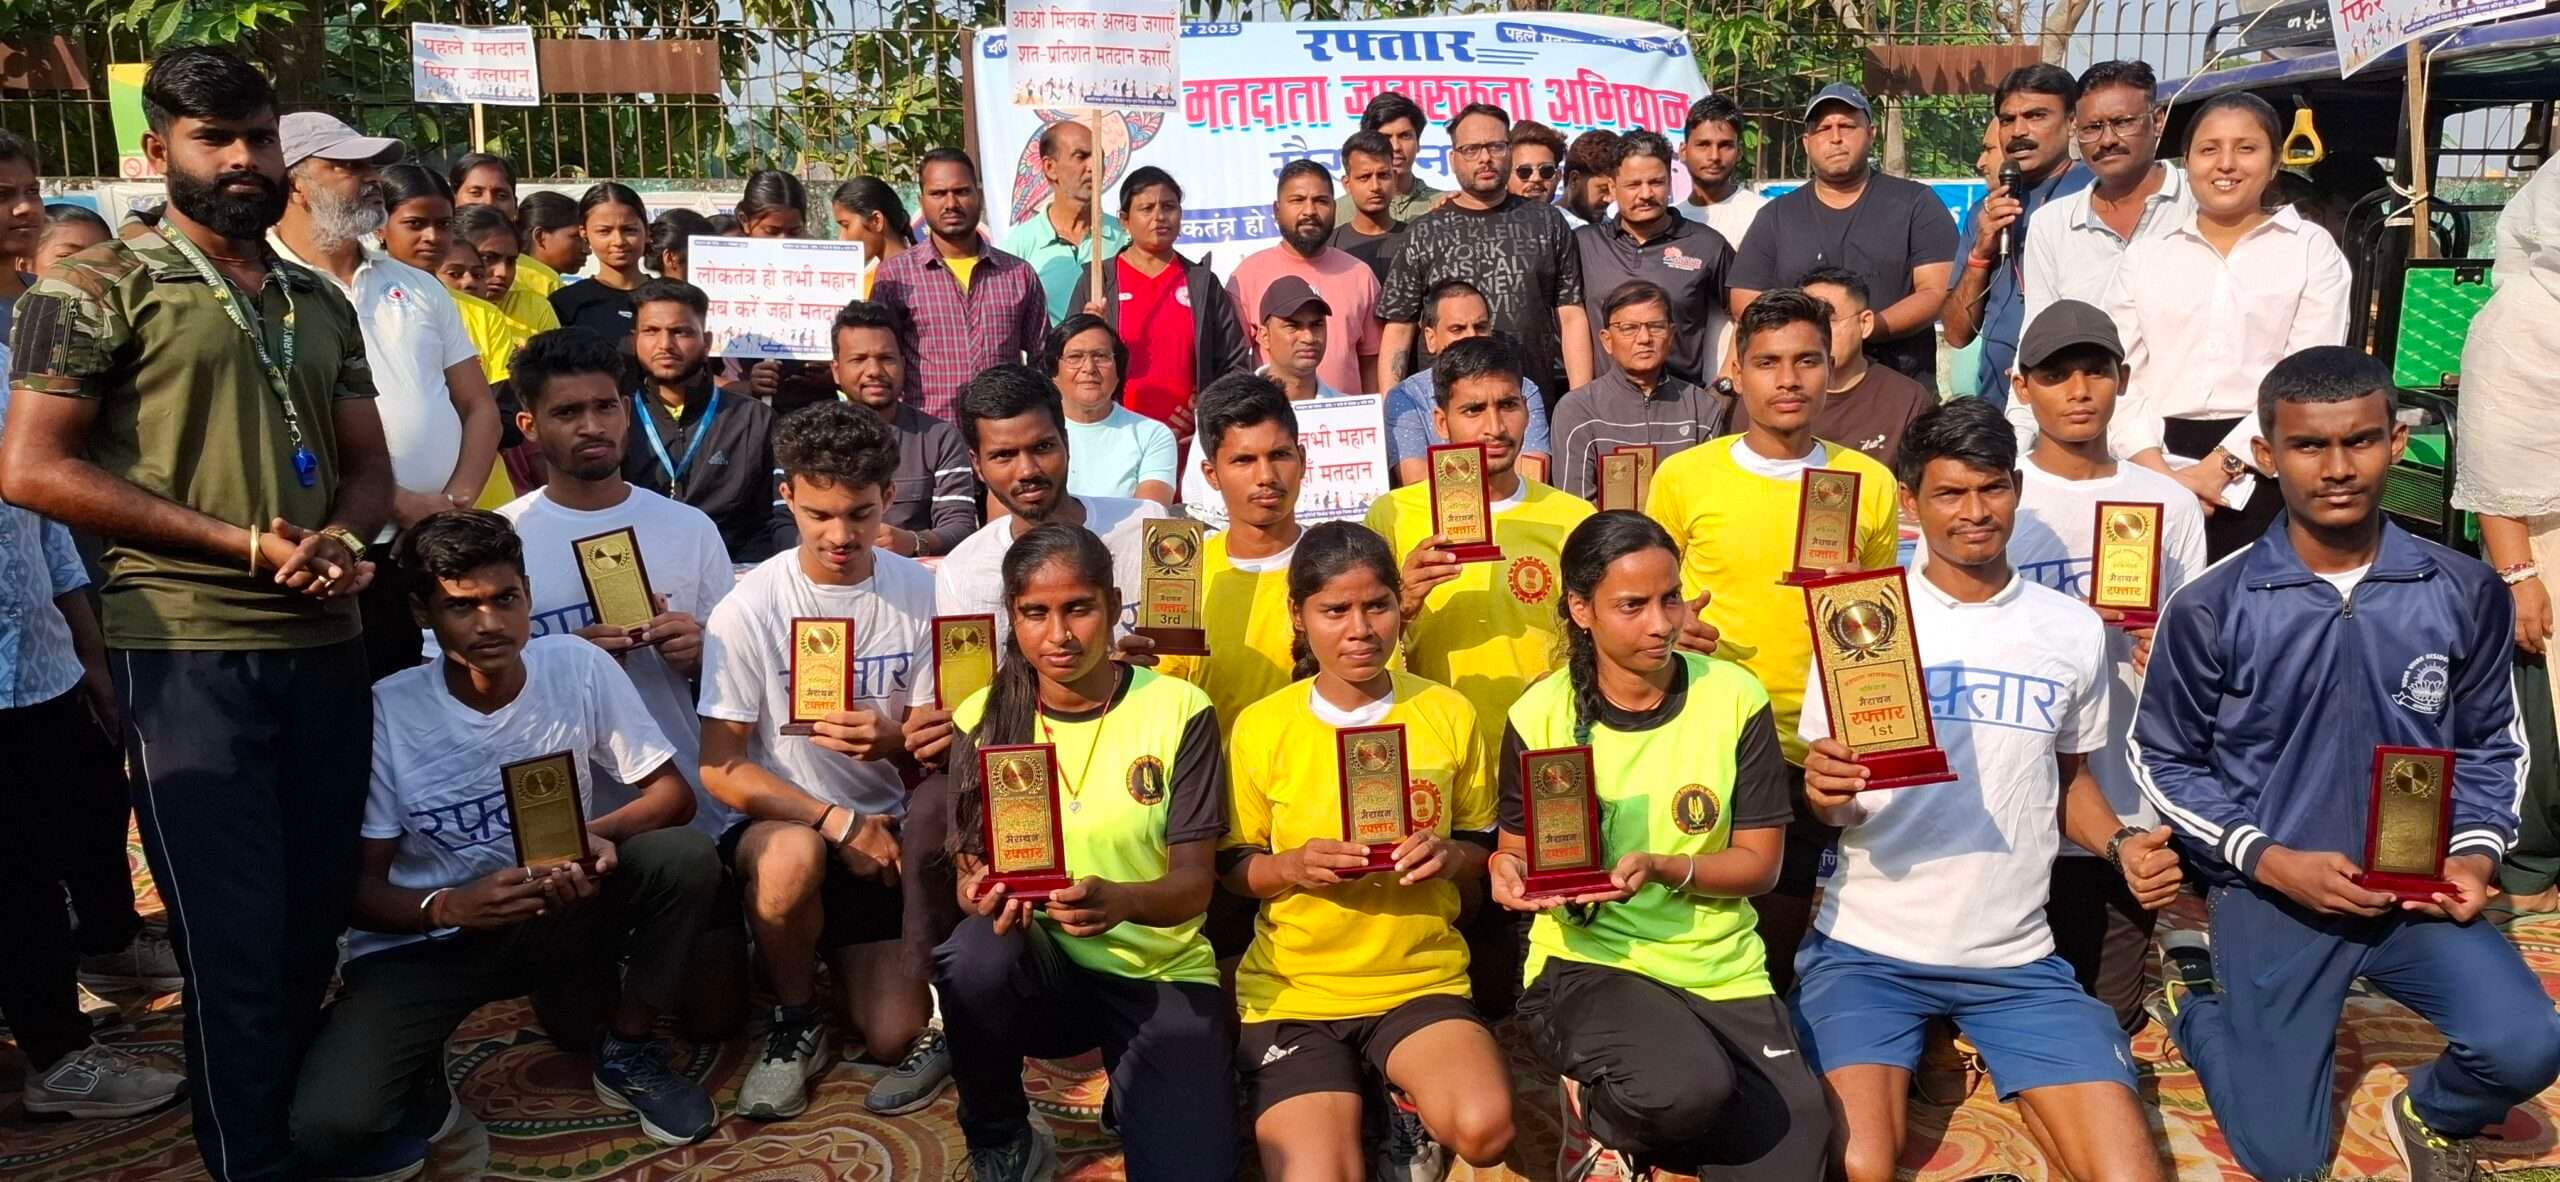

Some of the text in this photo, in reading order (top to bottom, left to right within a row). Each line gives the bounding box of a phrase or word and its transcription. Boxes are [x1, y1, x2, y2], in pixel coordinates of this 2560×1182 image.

[1012, 7, 1046, 33] आओ
[1051, 6, 1097, 31] मिलकर
[1102, 13, 1137, 33] अलख
[1199, 24, 1239, 35] 2025
[1501, 25, 1538, 43] पहले
[422, 35, 526, 58] पहले मतदान
[1017, 40, 1091, 65] शत-प्रतिशत
[1096, 46, 1134, 65] मतदान
[1296, 29, 1476, 63] रफ्तार
[422, 61, 530, 83] फिर जलपान
[1182, 76, 1330, 131] मतदाता
[1546, 67, 1690, 132] अभियान
[1180, 208, 1266, 242] कतंत्र हो
[696, 260, 857, 289] लोकतंत्र हो तभी महान
[799, 303, 847, 321] मतदा
[1336, 427, 1376, 448] महान
[1319, 461, 1373, 483] मतदान
[1160, 614, 1181, 625] 3rd
[1848, 705, 1906, 725] रफ्तार
[1869, 724, 1894, 736] 1st
